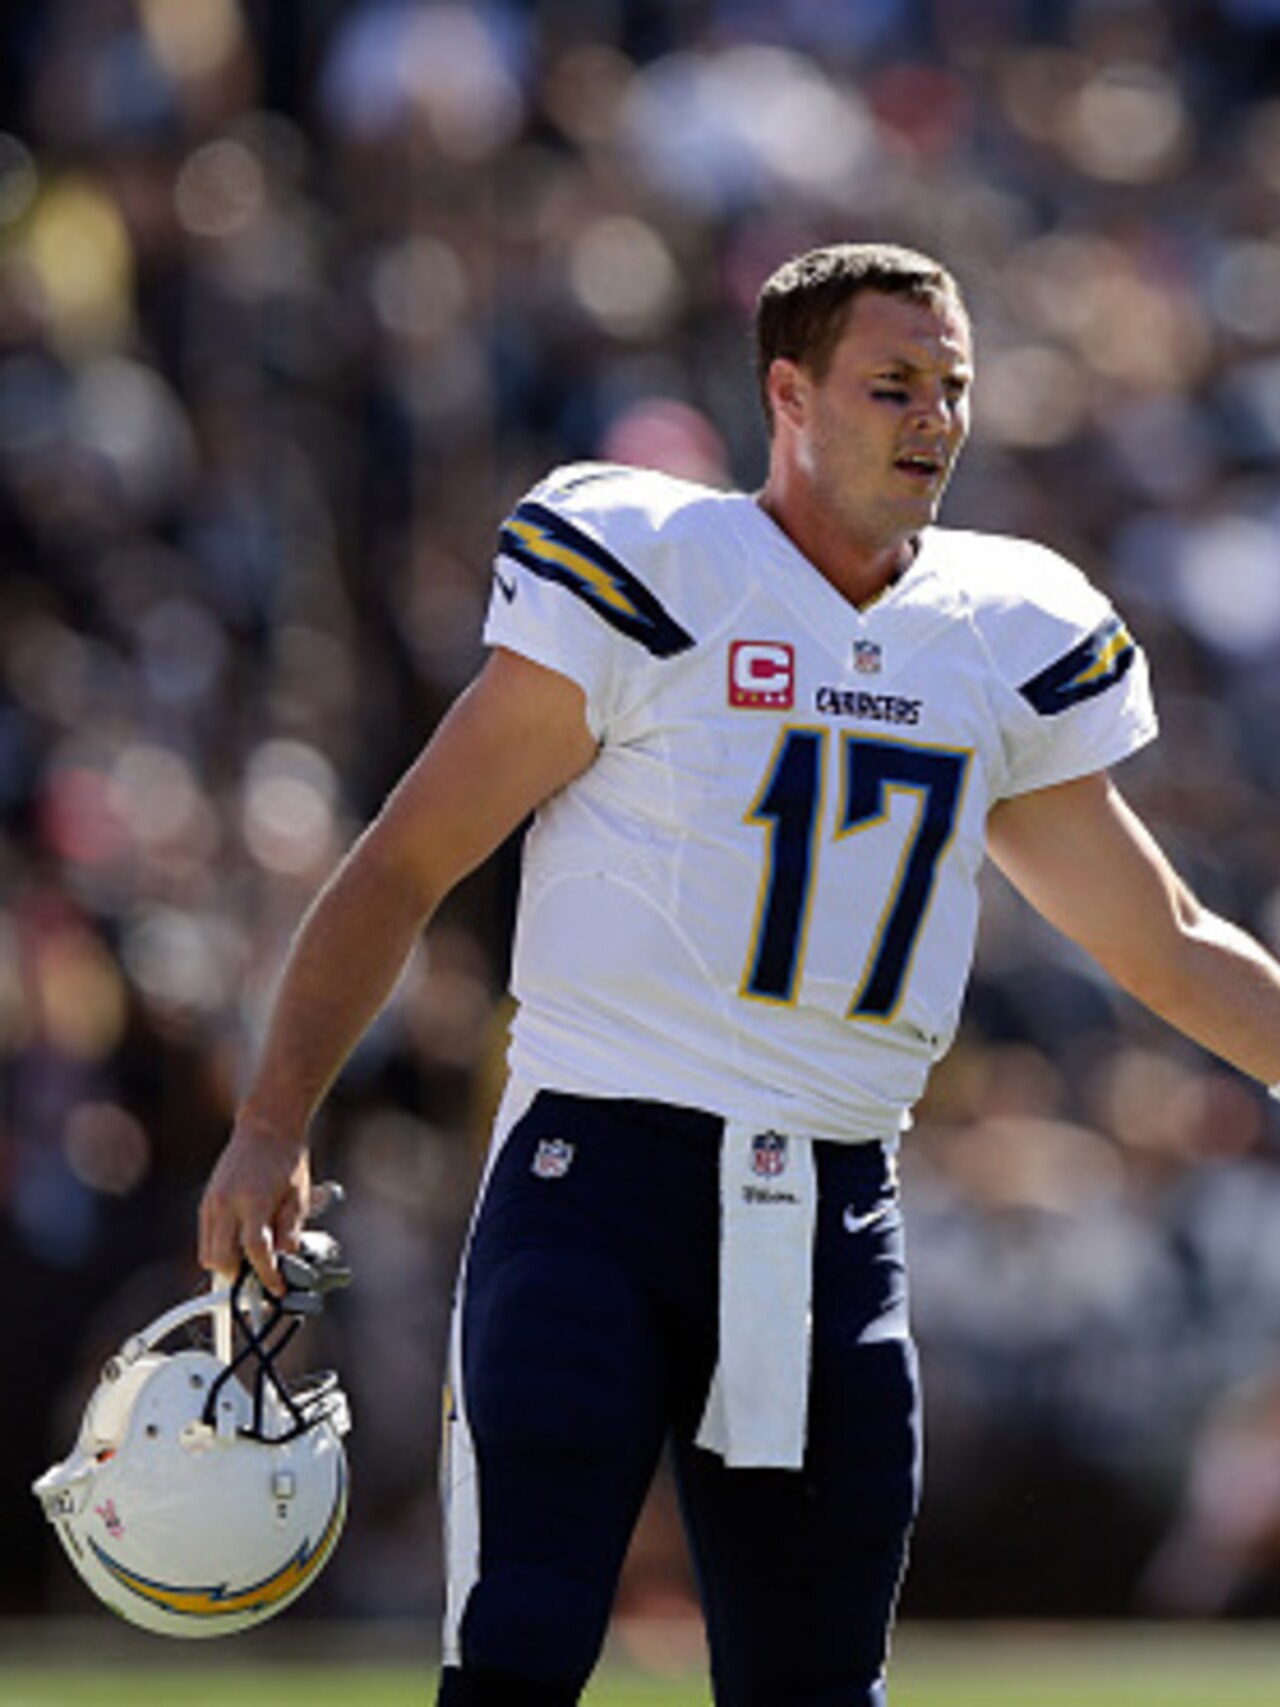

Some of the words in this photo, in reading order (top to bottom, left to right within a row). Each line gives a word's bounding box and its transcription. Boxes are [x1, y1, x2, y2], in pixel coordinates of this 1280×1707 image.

[733, 645, 790, 692] C
[816, 686, 922, 725] CHARGERS
[739, 723, 976, 1025] 17
